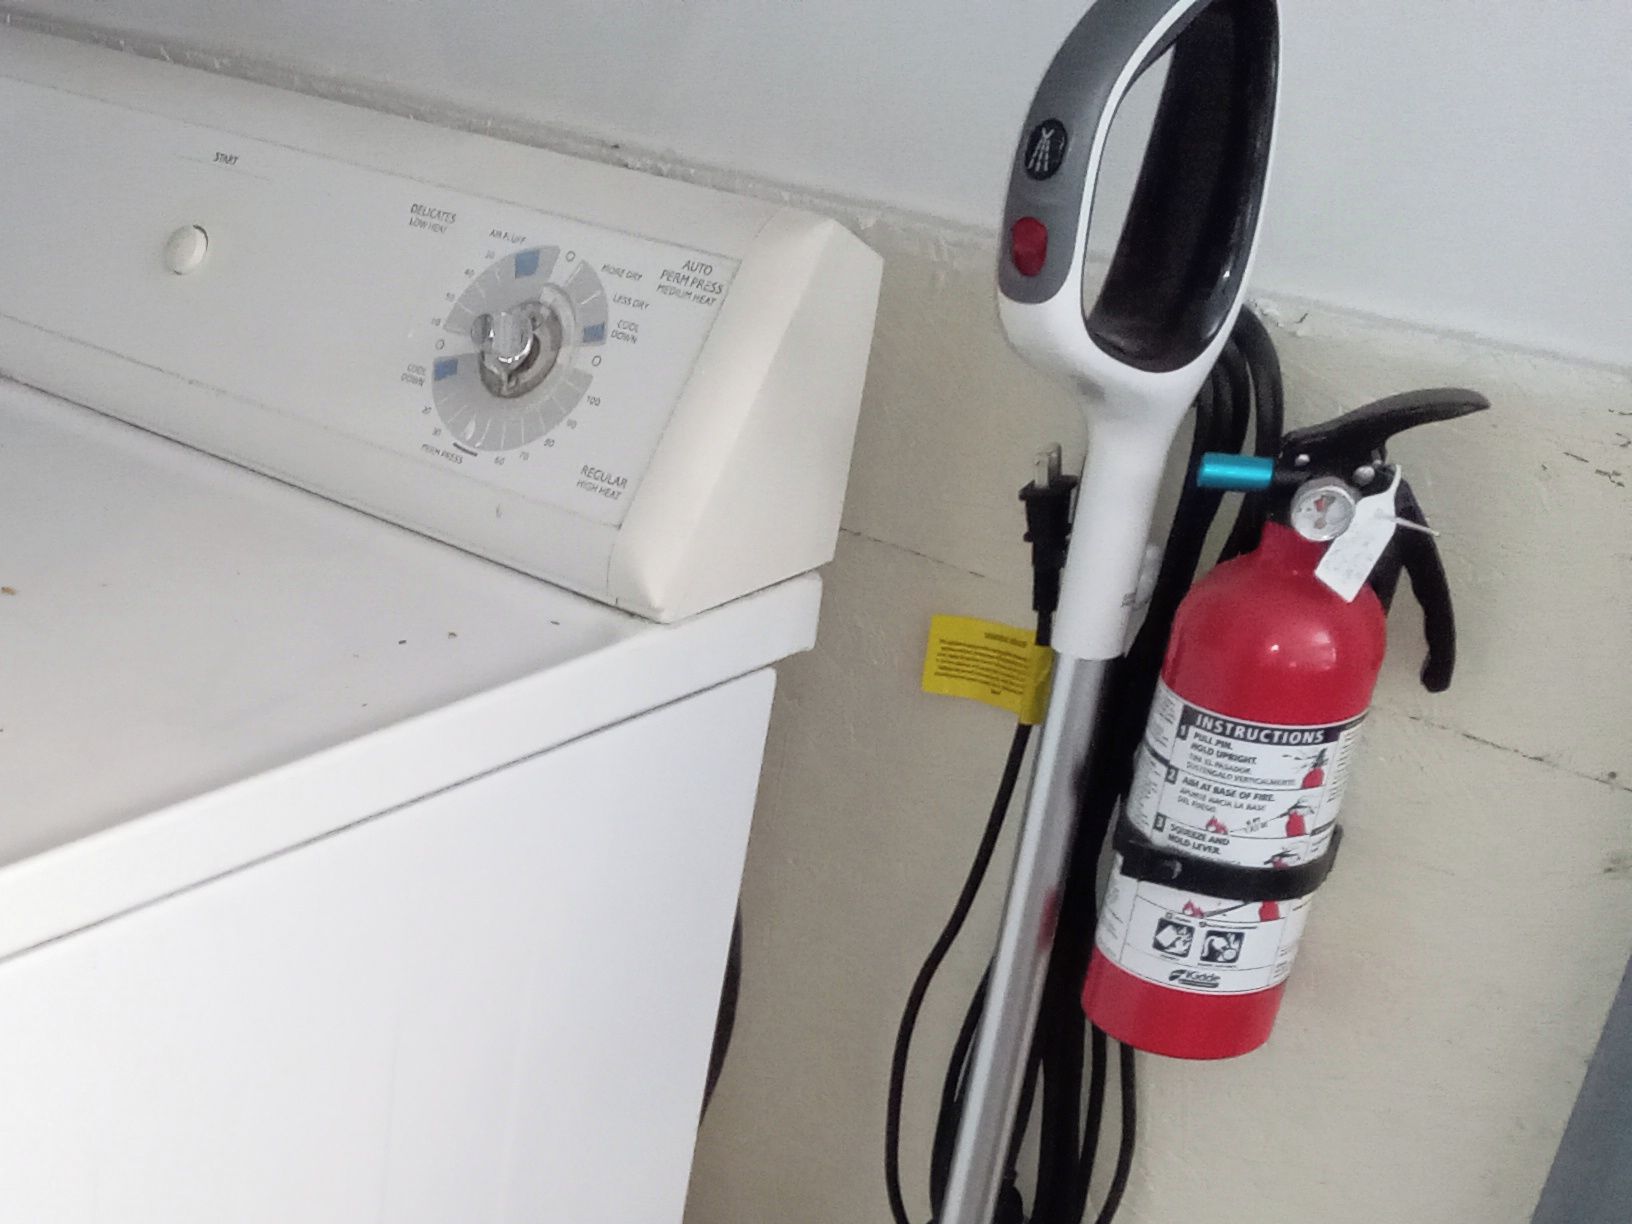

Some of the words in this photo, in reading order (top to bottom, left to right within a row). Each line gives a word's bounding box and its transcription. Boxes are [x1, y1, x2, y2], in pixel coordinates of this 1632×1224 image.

[410, 203, 456, 224] DELICATES
[681, 260, 713, 276] AUTO
[660, 269, 690, 287] PERM
[690, 277, 724, 295] PRESS
[656, 284, 692, 299] MEDIUM
[692, 294, 717, 305] HEAT
[580, 464, 628, 489] REGULAR
[1193, 730, 1213, 745] PULL
[1195, 714, 1325, 744] INSTRUCTIONS
[1190, 743, 1214, 756] HOLD
[1182, 776, 1199, 788] AIM
[1200, 781, 1211, 791] AT
[1213, 784, 1237, 798] BASE
[1239, 791, 1251, 800] OF
[1168, 834, 1191, 847] HOLD
[1170, 823, 1207, 843] SQUEEZE
[1208, 835, 1230, 846] AND
